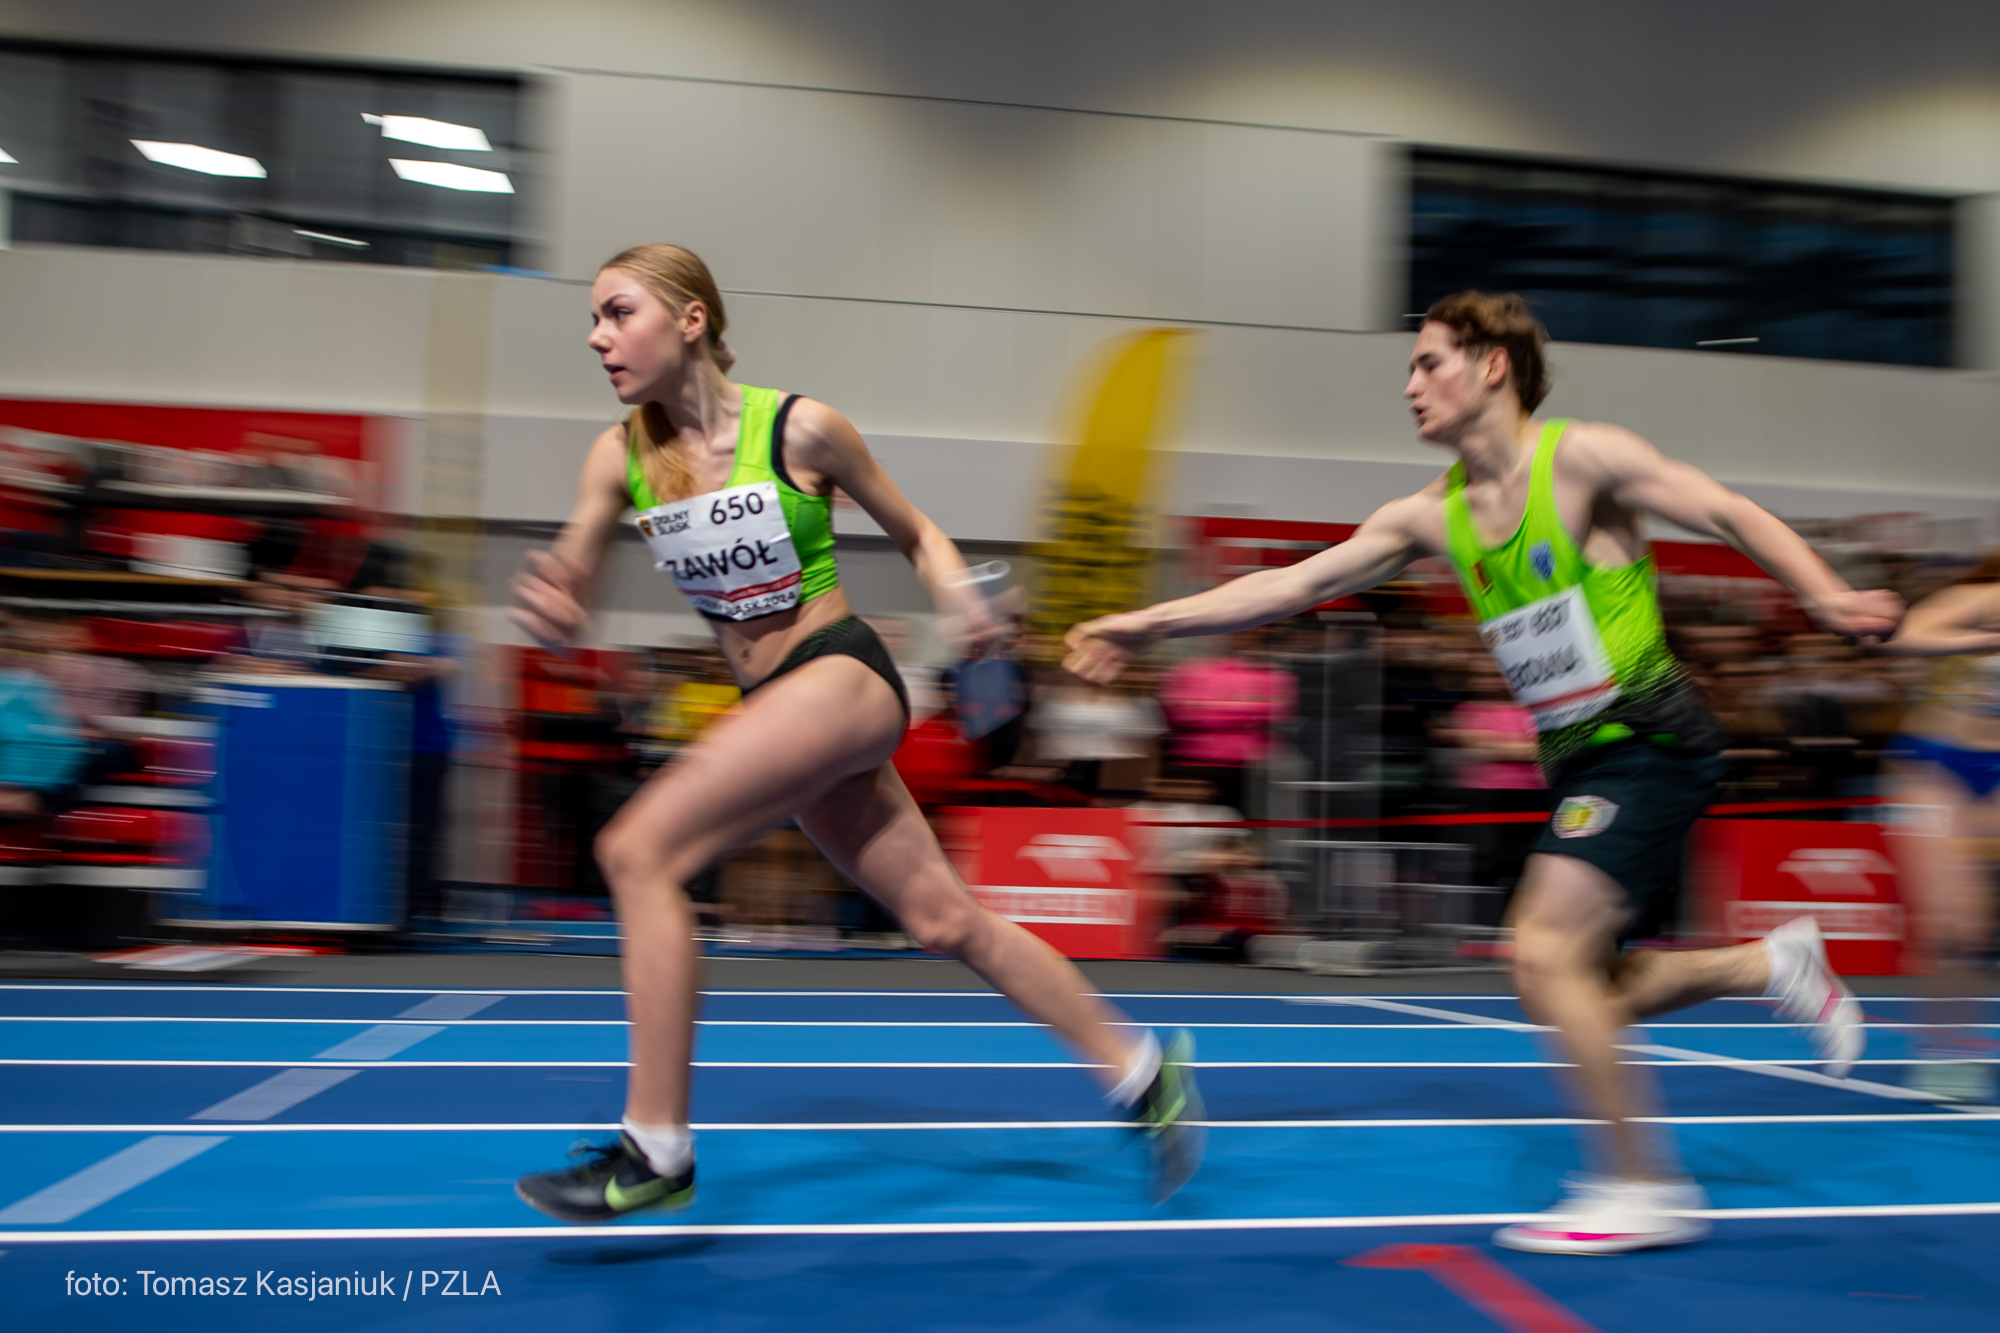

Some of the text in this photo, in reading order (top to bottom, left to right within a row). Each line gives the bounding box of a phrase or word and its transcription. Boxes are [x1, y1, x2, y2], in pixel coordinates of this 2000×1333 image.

[710, 492, 764, 525] 650
[664, 537, 779, 581] ZAWÓŁ
[763, 591, 796, 608] 2024
